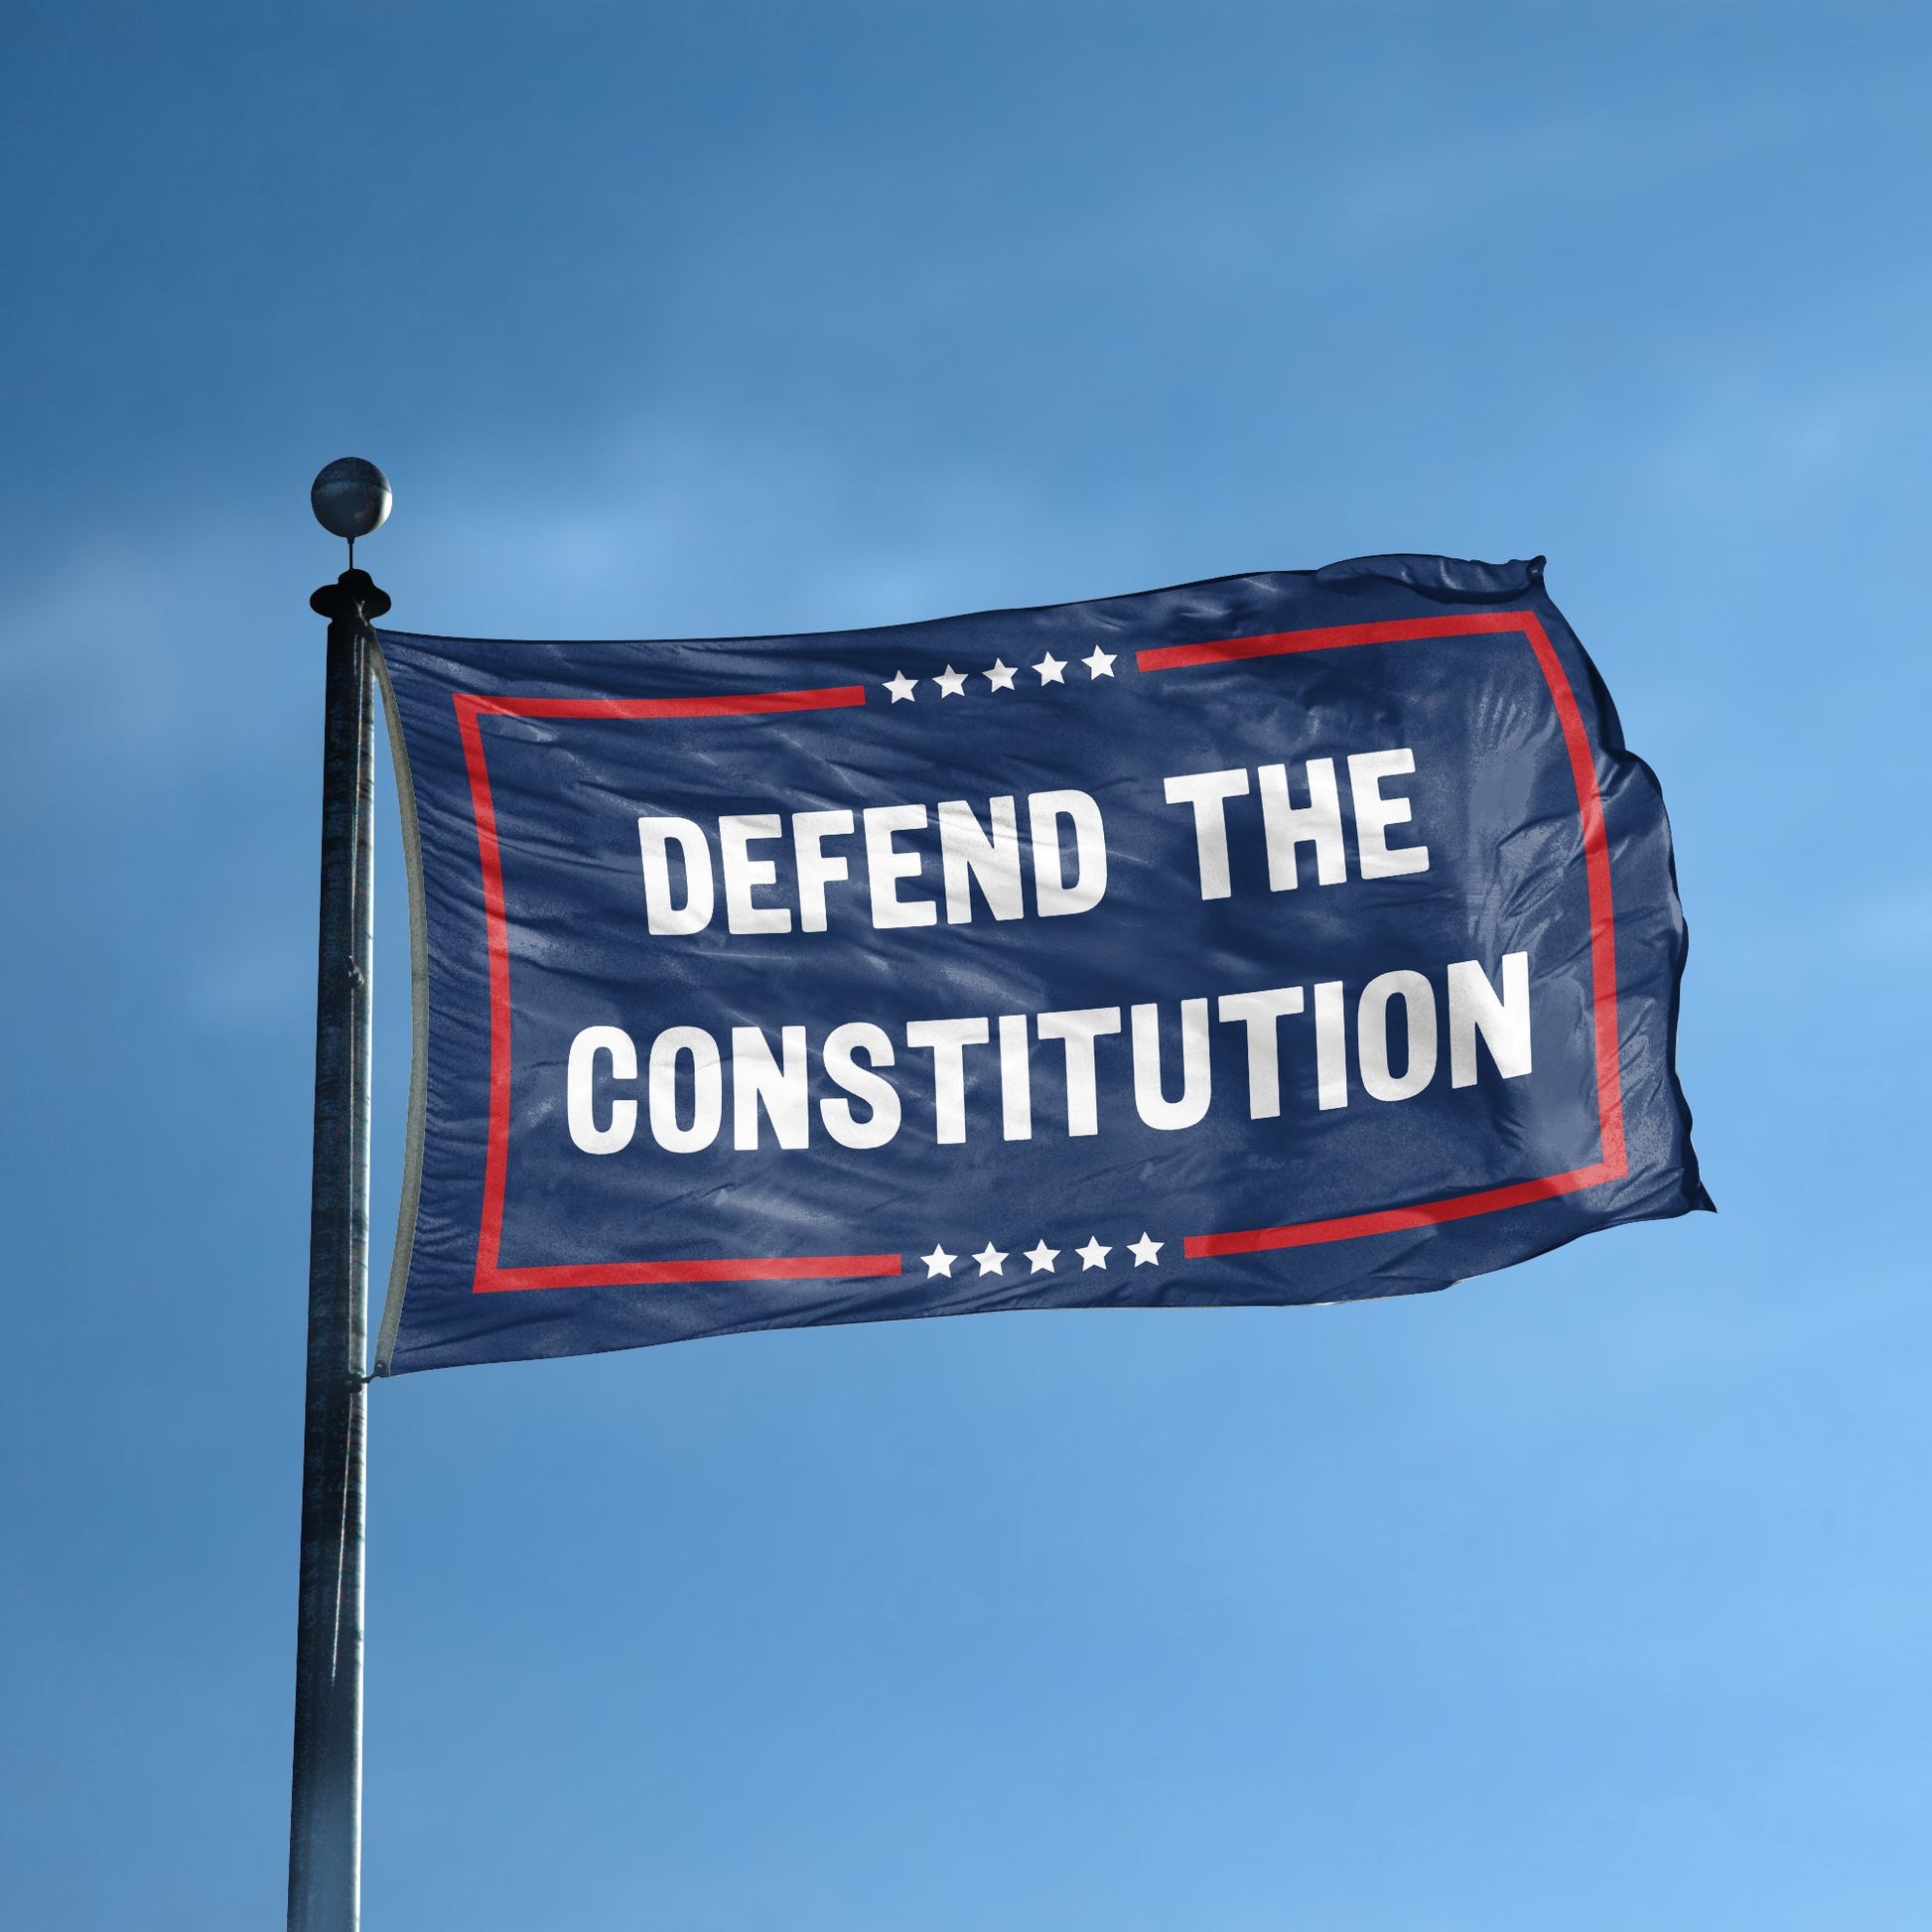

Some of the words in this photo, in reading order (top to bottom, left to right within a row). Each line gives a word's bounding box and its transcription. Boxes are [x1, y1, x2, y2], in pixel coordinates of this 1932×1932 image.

[637, 788, 1108, 936] DEFEND
[1163, 747, 1430, 901] THE
[566, 949, 1533, 1156] CONSTITUTION
